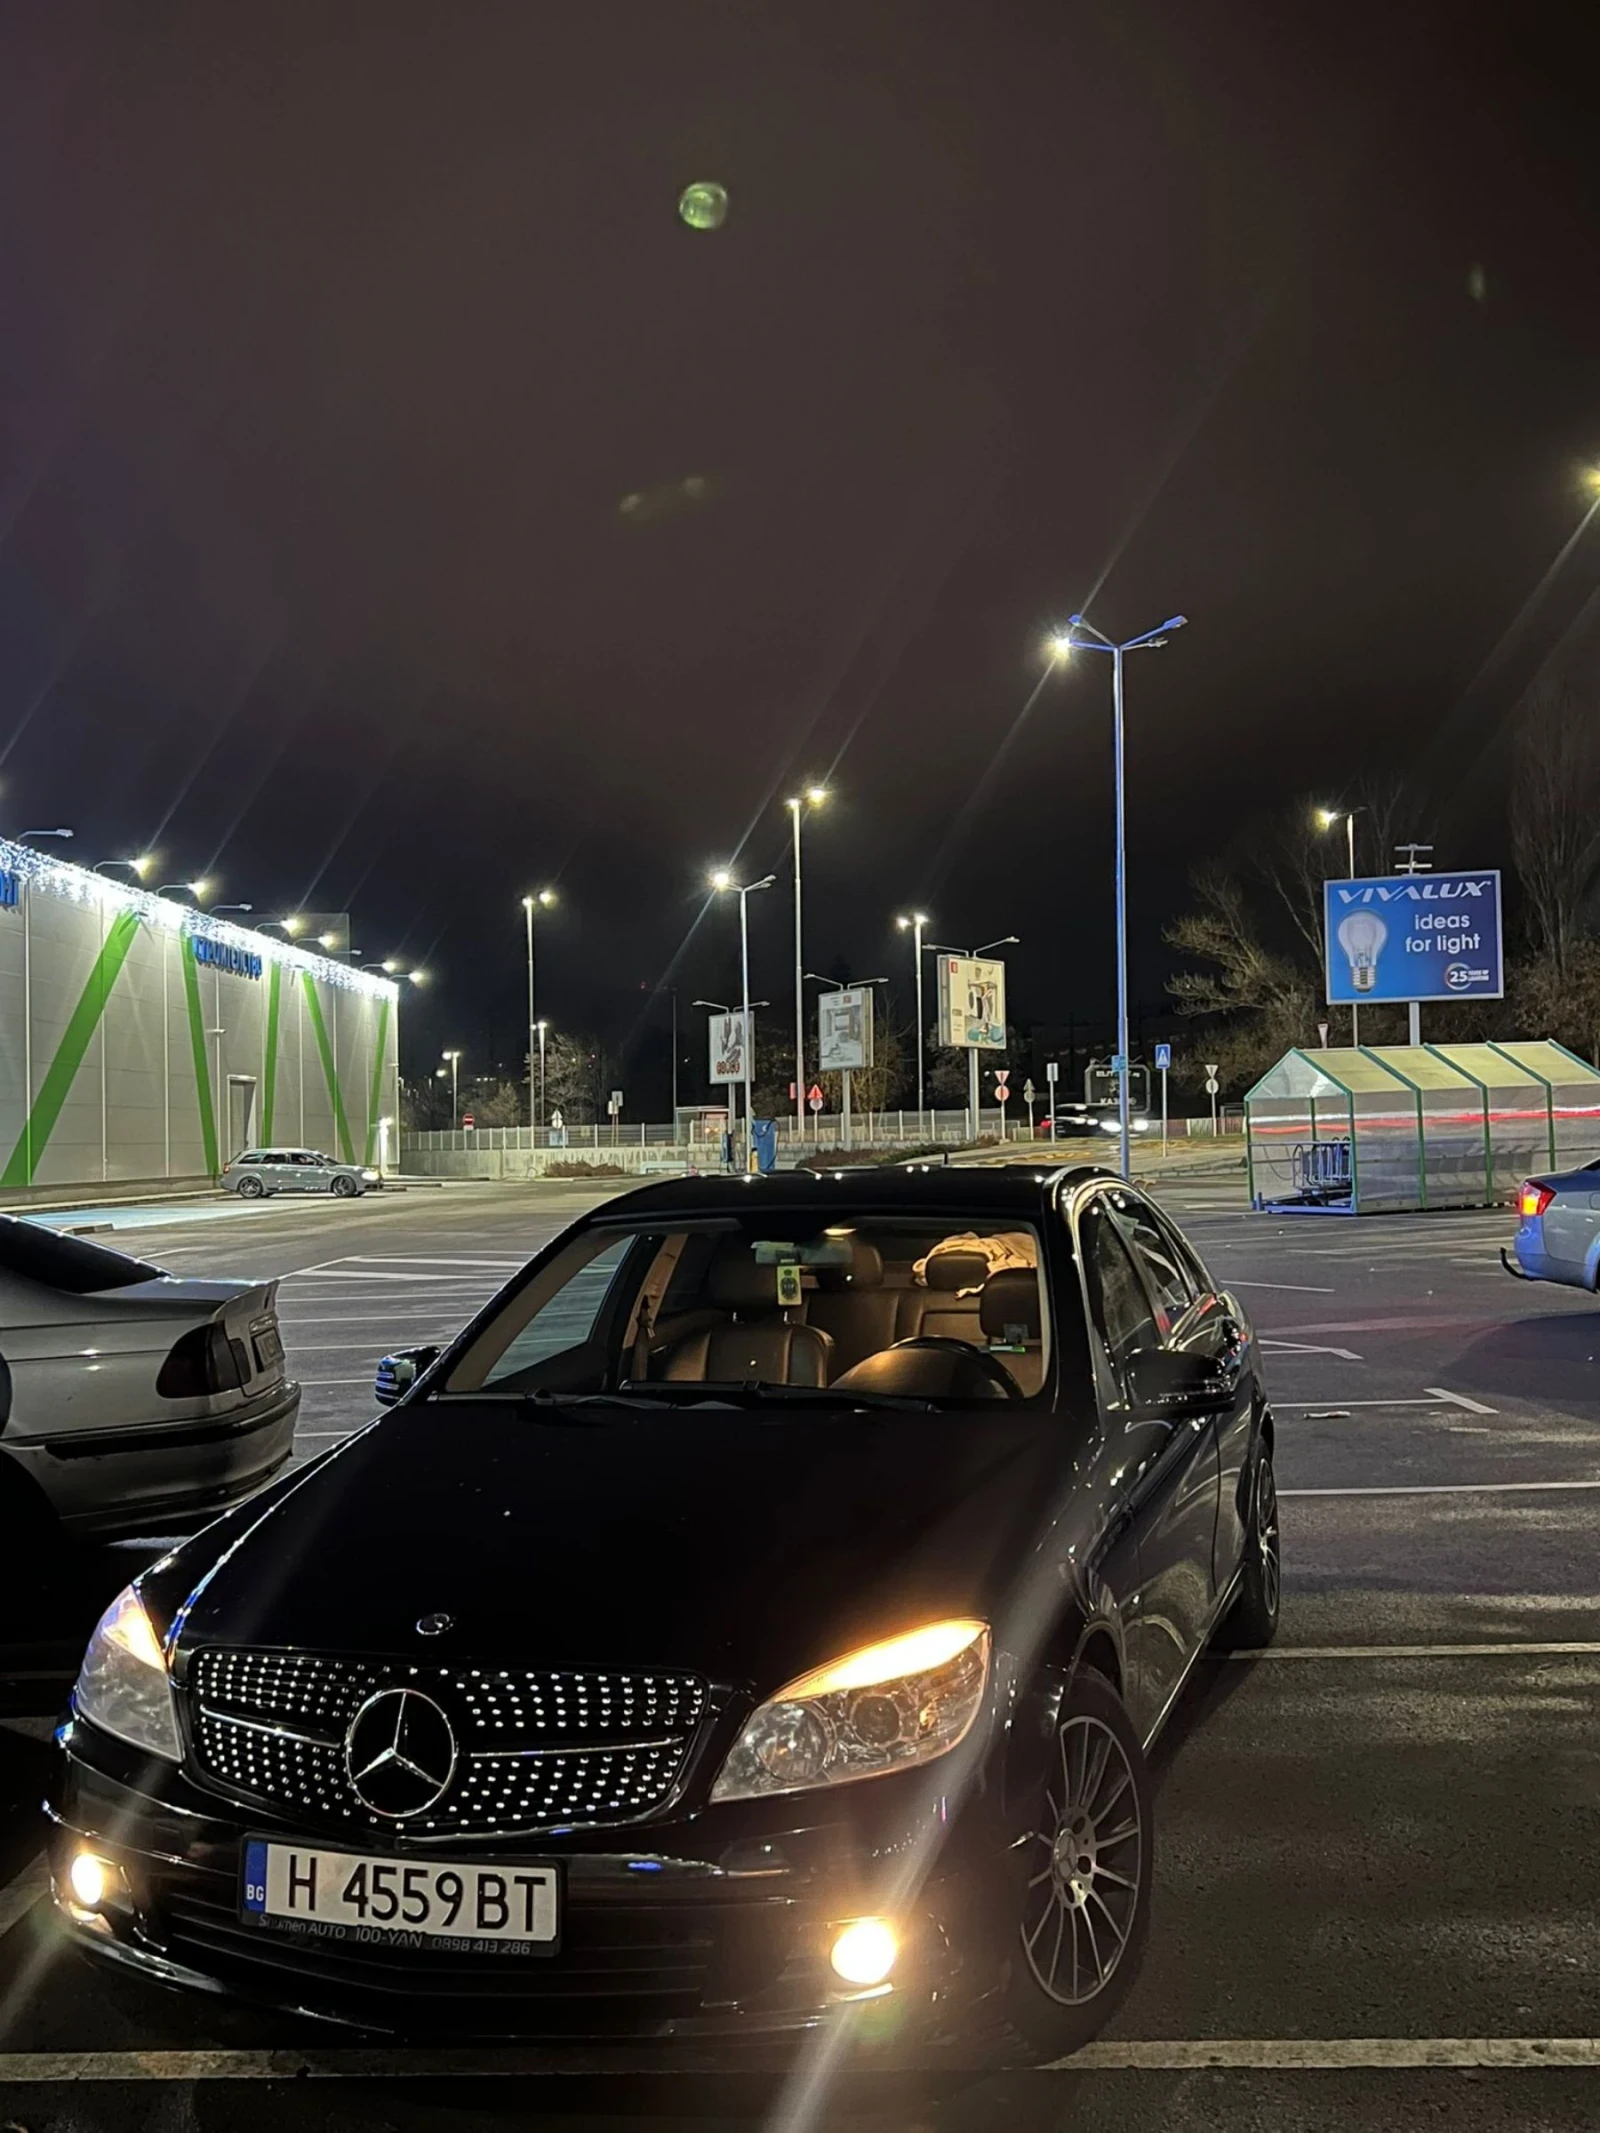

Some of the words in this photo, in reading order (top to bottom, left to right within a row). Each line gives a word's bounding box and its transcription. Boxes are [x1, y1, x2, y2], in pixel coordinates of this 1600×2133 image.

[1338, 881, 1490, 903] VIVALUX
[1415, 914, 1470, 930] ideas
[1405, 937, 1432, 952] for
[1437, 933, 1480, 954] light
[1450, 970, 1468, 982] 25
[247, 1884, 264, 1901] BG
[288, 1854, 317, 1911] H
[308, 1922, 346, 1939] AUTO
[501, 1942, 531, 1955] 286
